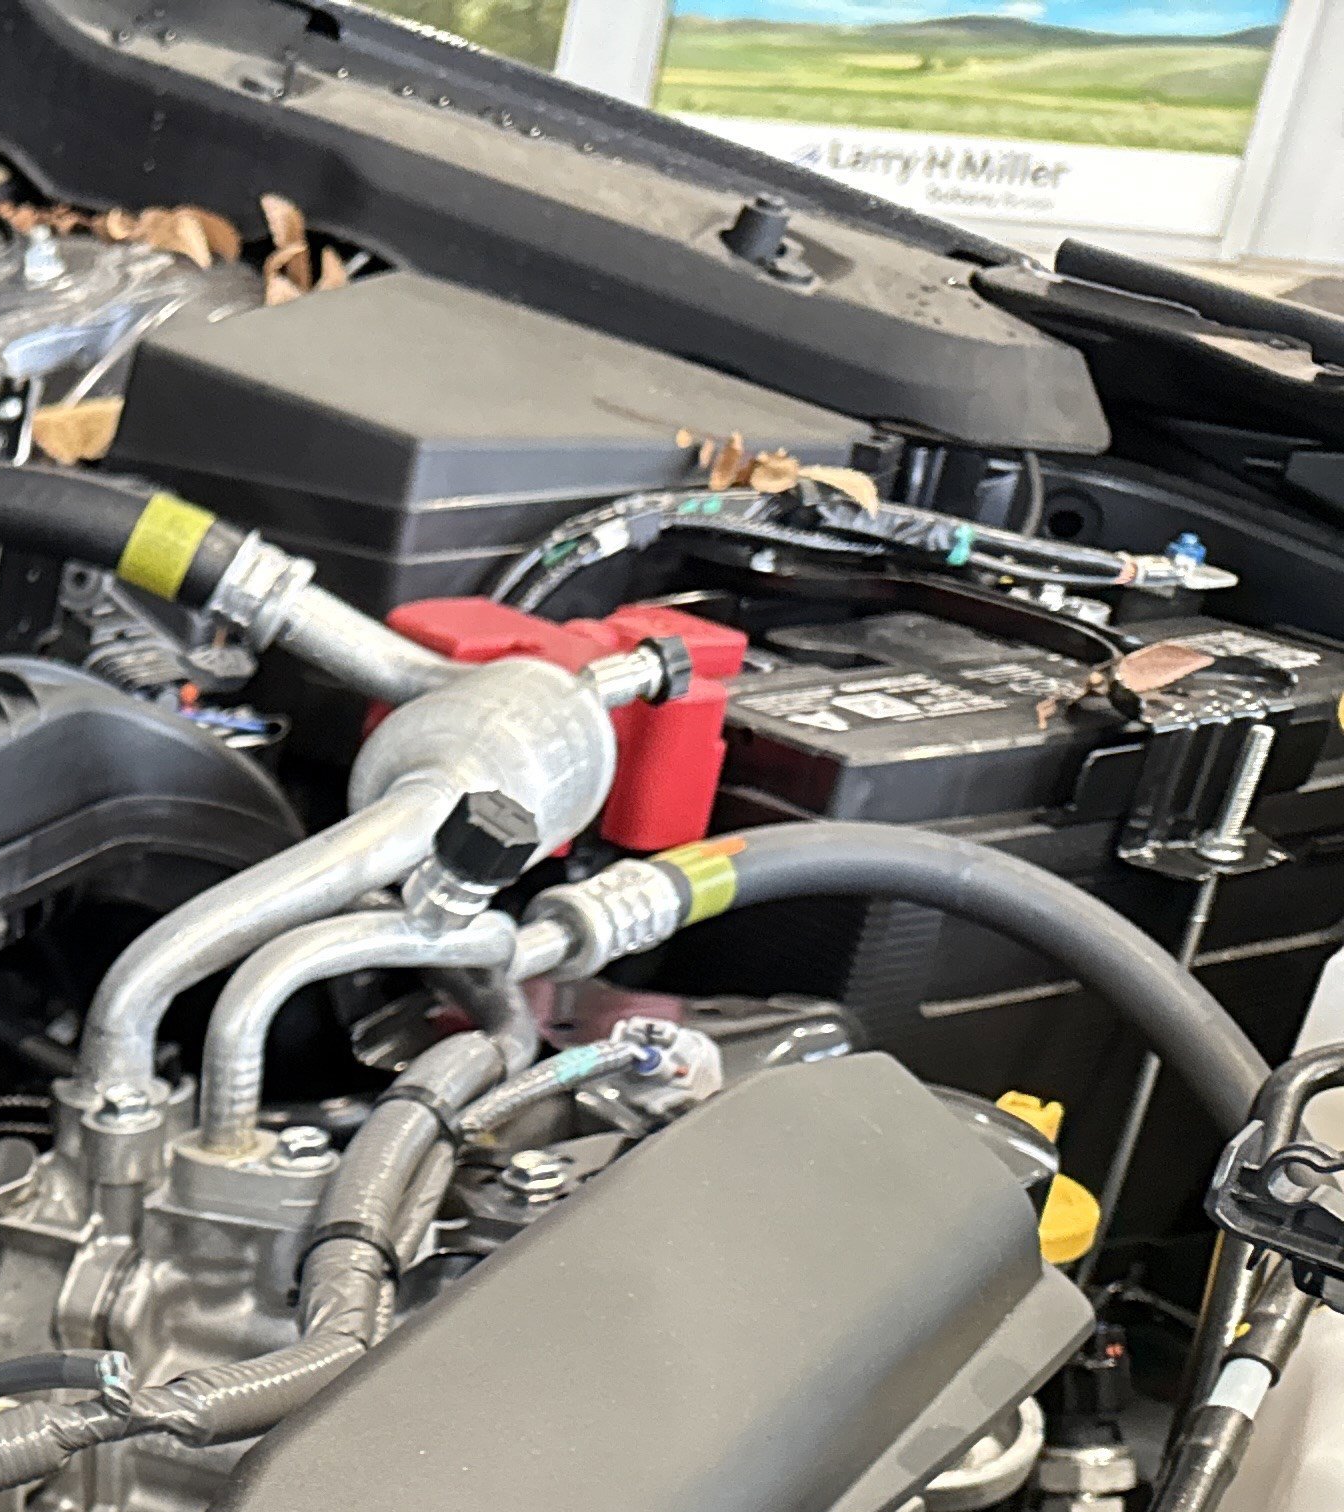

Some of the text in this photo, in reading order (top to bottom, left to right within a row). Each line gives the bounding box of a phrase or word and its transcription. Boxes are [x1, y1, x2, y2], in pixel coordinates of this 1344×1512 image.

[827, 138, 1070, 189] Larry H Miller
